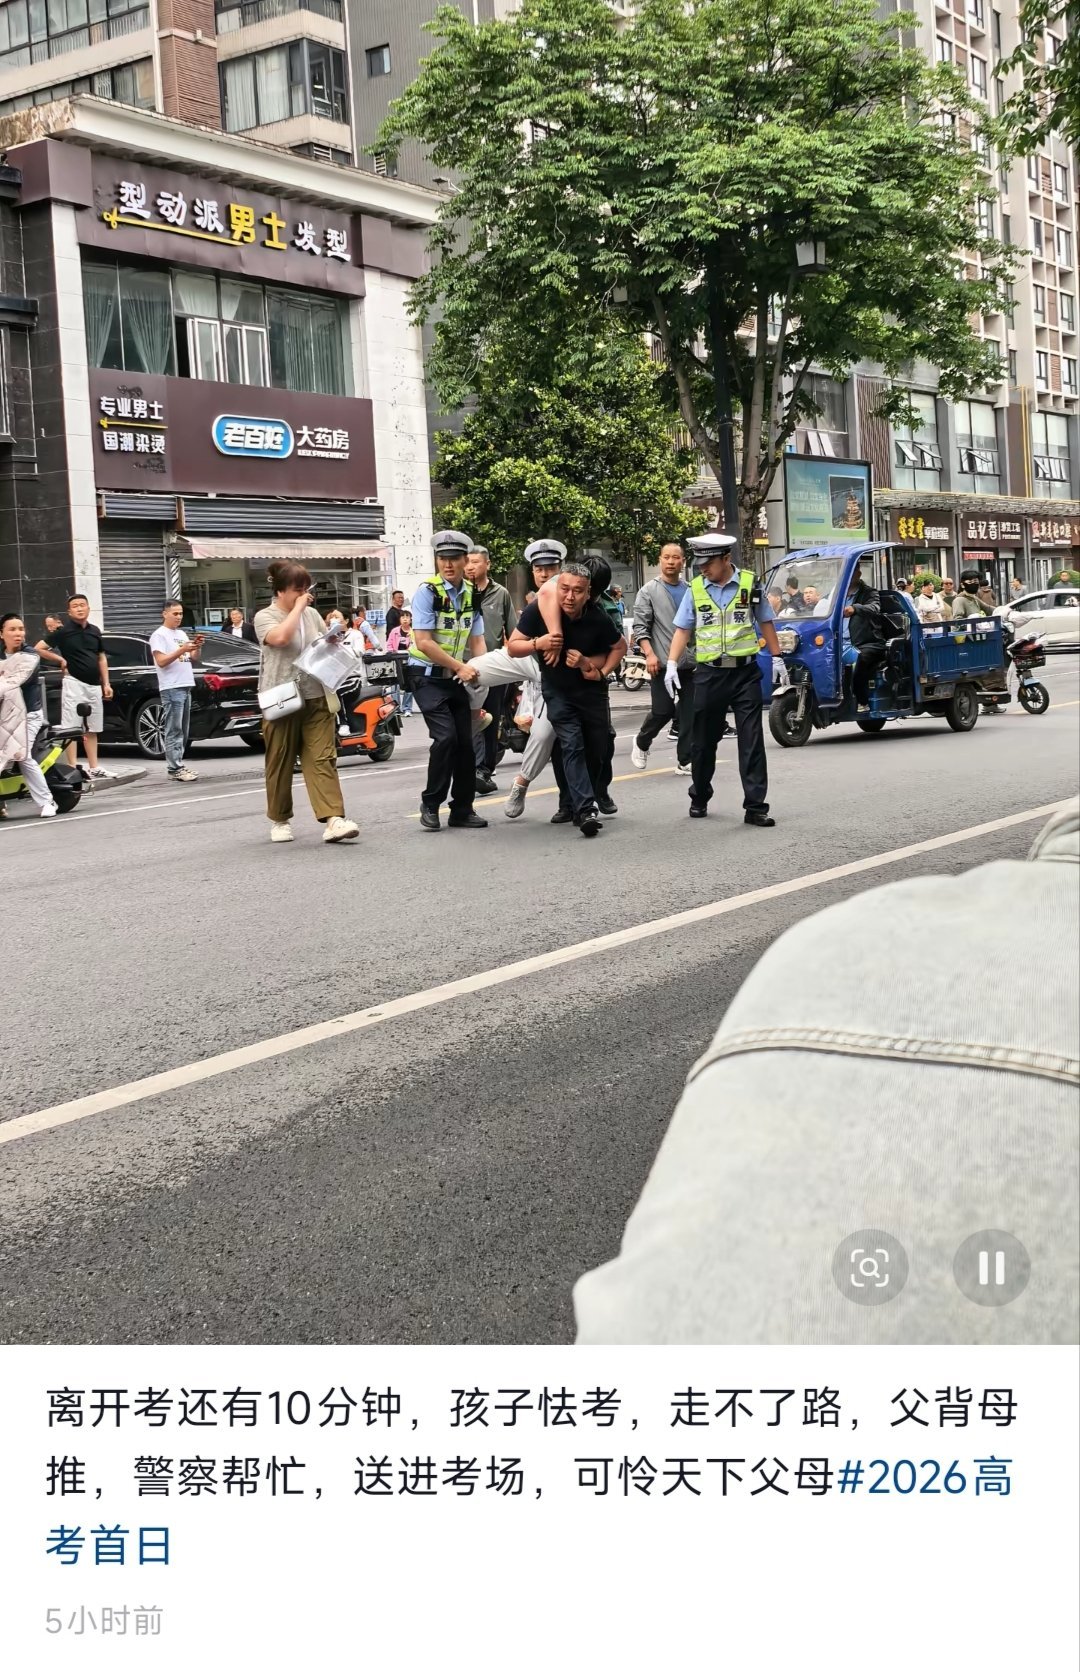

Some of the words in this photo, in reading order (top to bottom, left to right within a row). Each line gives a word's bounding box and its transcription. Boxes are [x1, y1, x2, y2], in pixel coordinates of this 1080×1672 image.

[119, 181, 351, 262] 型动派男士发型
[100, 396, 163, 420] 专业男士
[103, 431, 165, 454] 国潮染烫
[223, 422, 285, 451] 老百姓
[296, 425, 349, 450] 大药房
[443, 616, 471, 629] 警察
